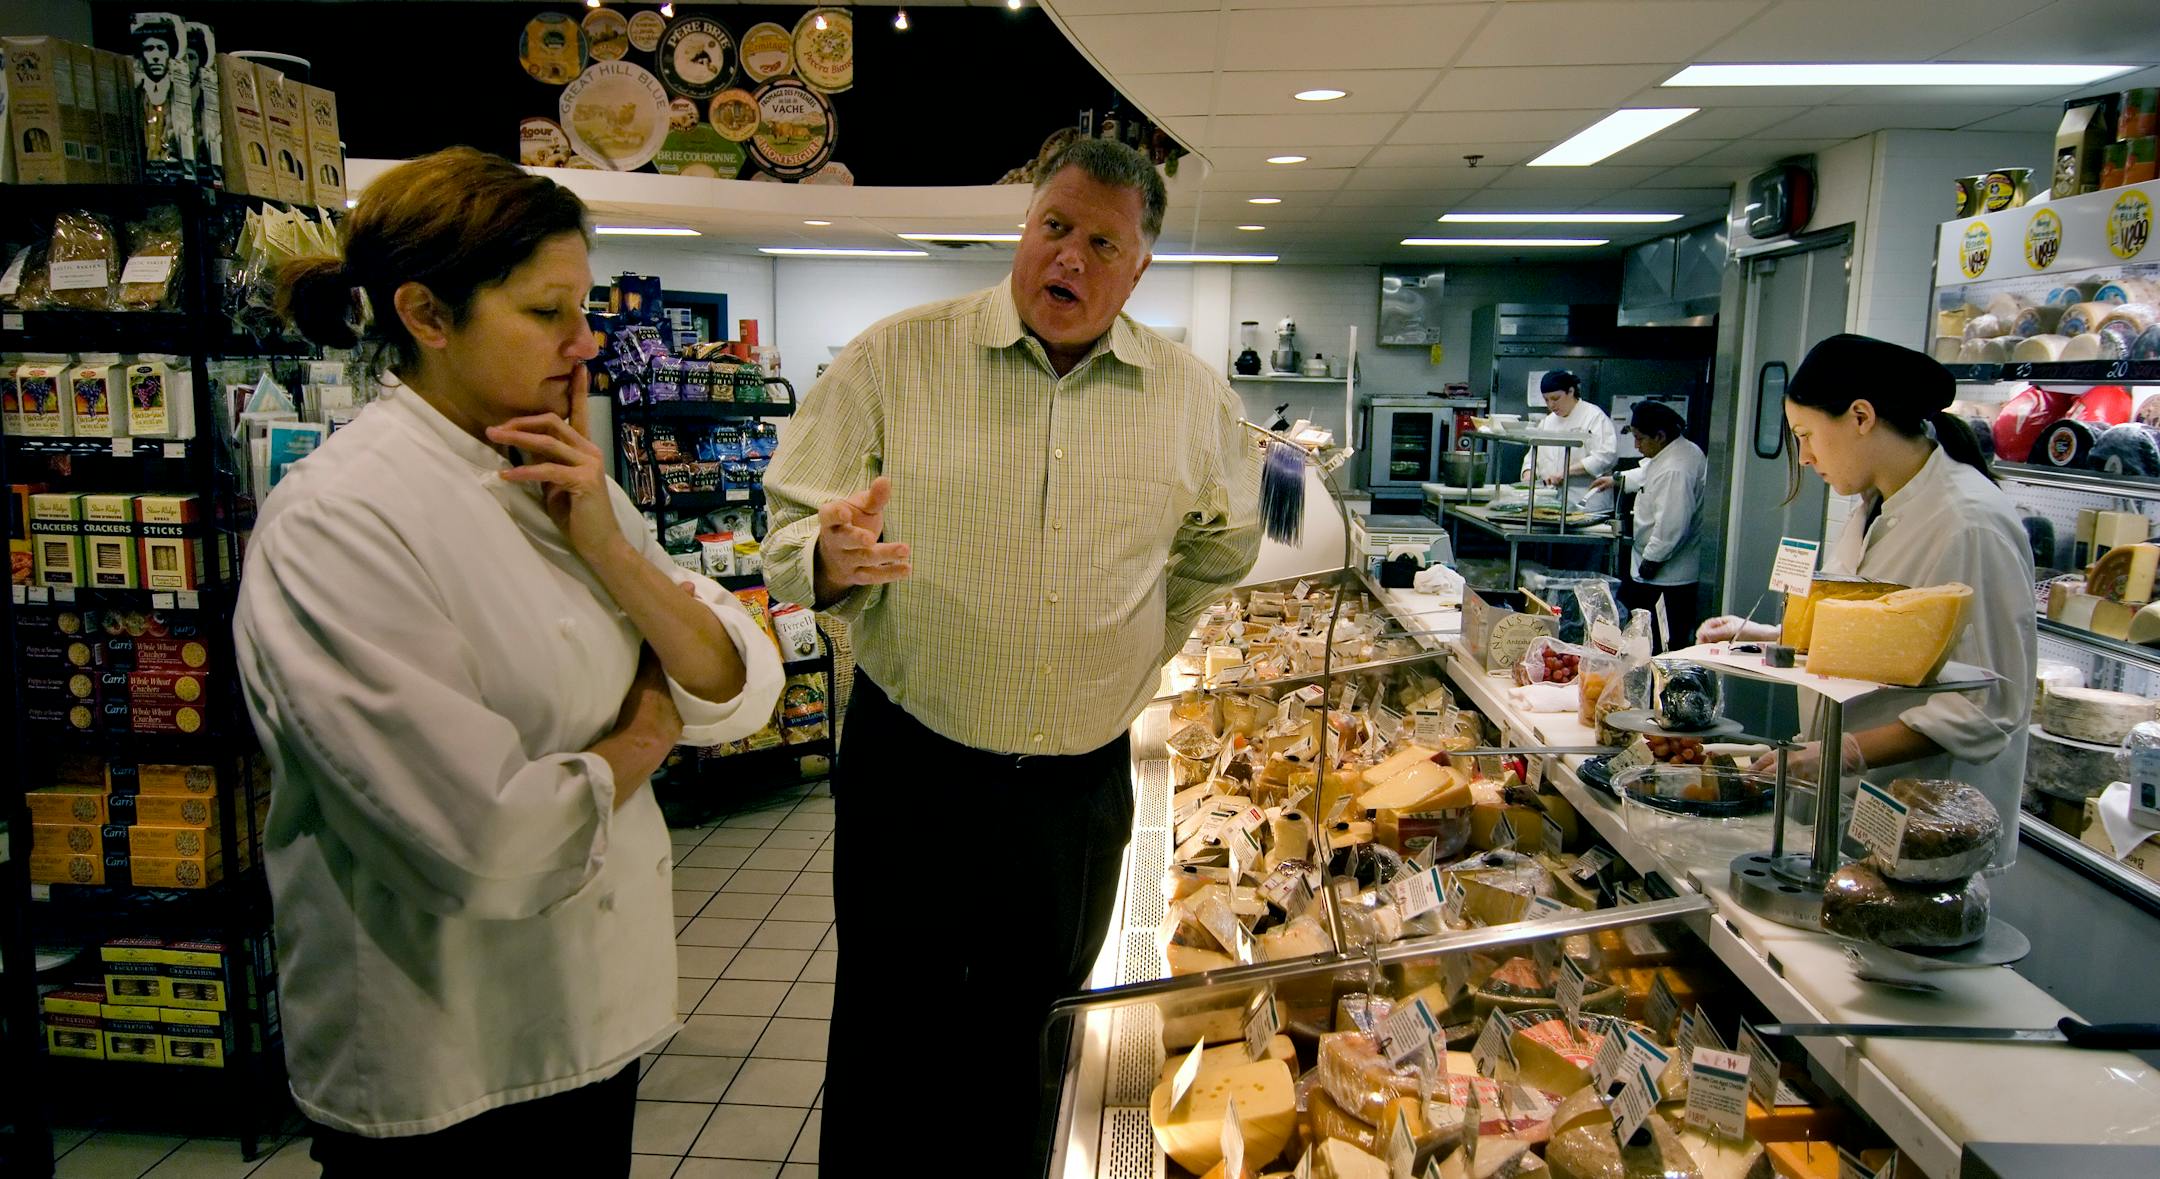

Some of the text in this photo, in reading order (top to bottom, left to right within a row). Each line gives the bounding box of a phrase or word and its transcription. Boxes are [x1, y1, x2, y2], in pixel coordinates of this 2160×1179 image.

[703, 22, 732, 49] BRIE
[561, 64, 665, 114] GREAT HILL BLUE
[772, 105, 804, 114] VACHE
[657, 150, 737, 164] BRIE COURONNE
[2106, 361, 2128, 378] 20
[31, 522, 79, 532] CRACKERS
[84, 523, 132, 534] CRACKERS
[143, 526, 183, 536] STICKS
[1492, 616, 1522, 650] NEAL'S
[109, 639, 133, 650] Carr's
[137, 643, 177, 652] Whole Wheat
[102, 673, 126, 684] Carr's
[130, 677, 171, 686] Whole Wheat
[105, 703, 128, 714] Carr's
[132, 707, 172, 716] Whole Wheat
[110, 796, 134, 807] Carr's
[103, 828, 127, 838] Carr's
[105, 857, 128, 867] Carr's
